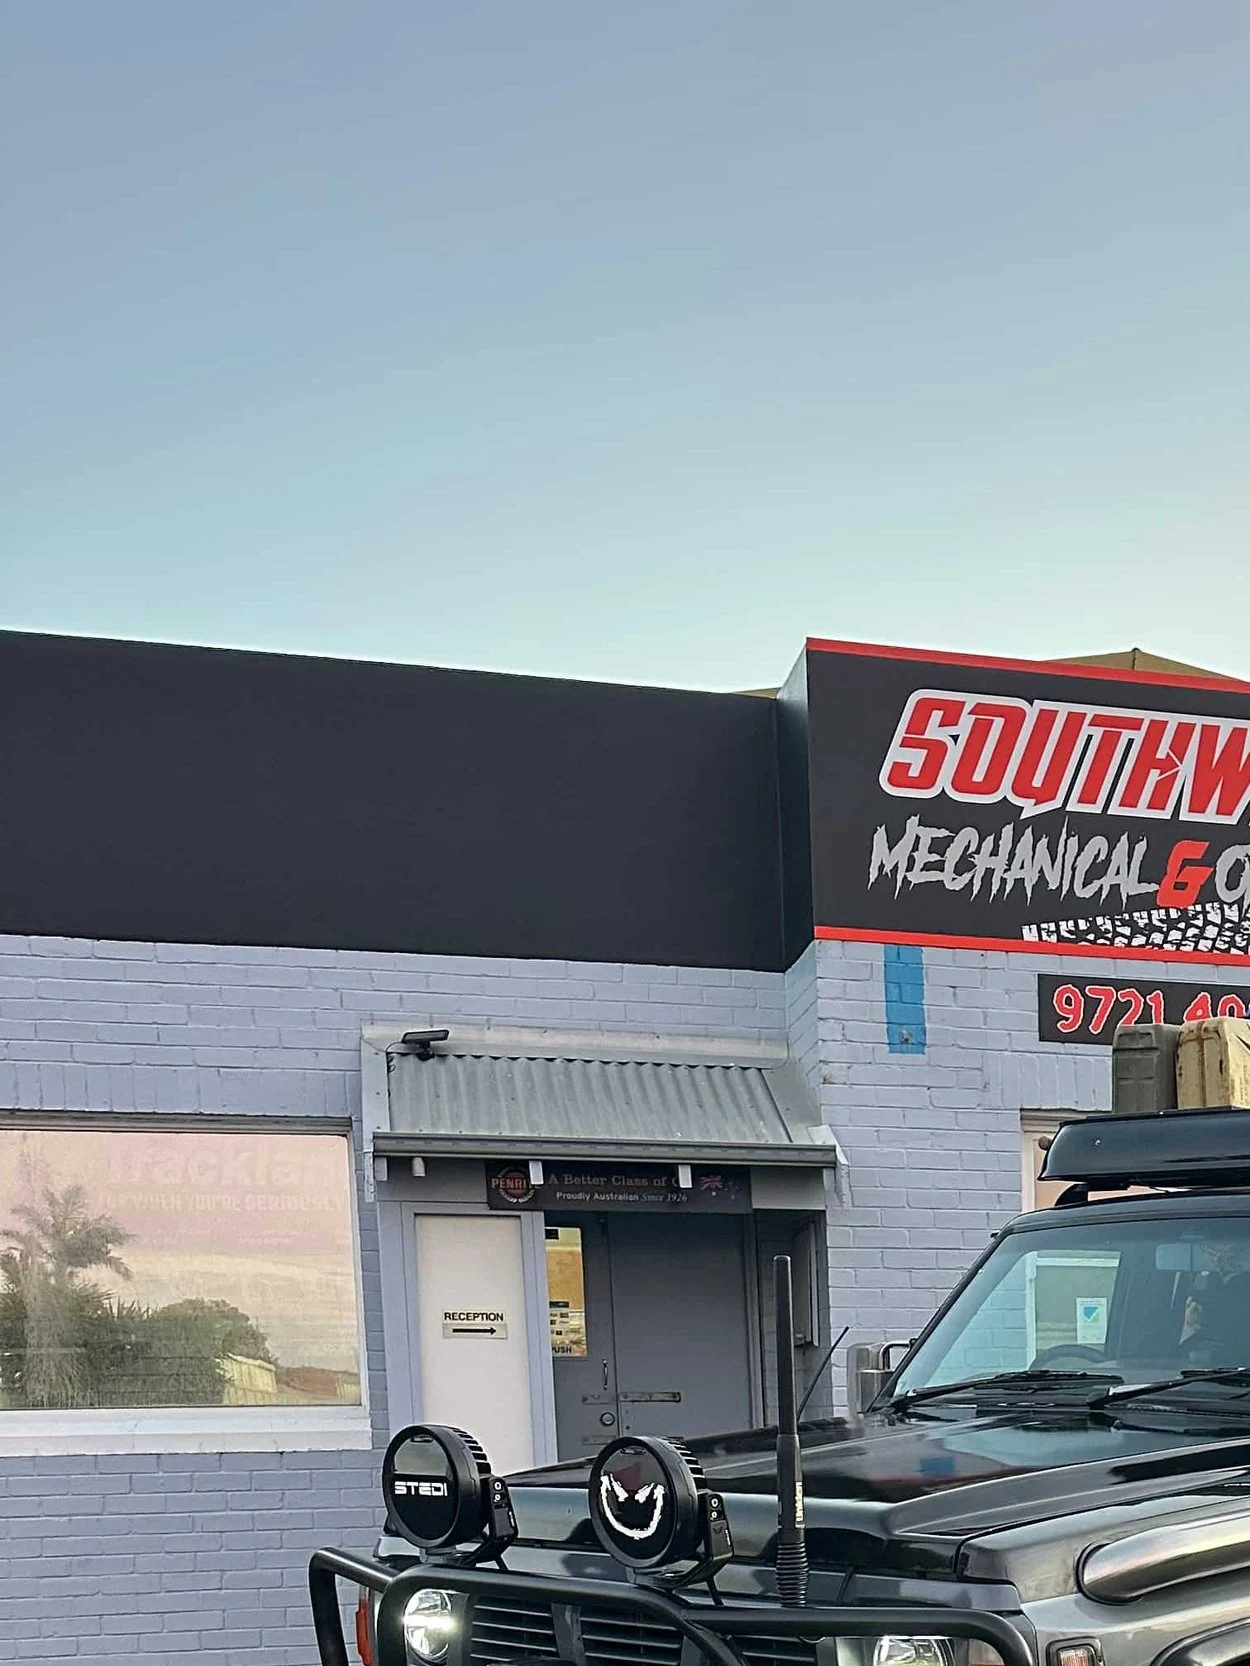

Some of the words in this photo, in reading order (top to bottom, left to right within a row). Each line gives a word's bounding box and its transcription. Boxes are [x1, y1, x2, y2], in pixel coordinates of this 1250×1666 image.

[867, 814, 1160, 910] MECHANICAL
[1053, 984, 1165, 1035] 9721
[491, 1178, 541, 1189] PENRI
[548, 1174, 559, 1185] A
[563, 1174, 607, 1186] Better
[612, 1175, 648, 1187] Class
[653, 1176, 667, 1187] of
[556, 1191, 590, 1201] Proudly
[593, 1192, 639, 1202] Australian
[444, 1312, 504, 1322] RECEPTION
[395, 1481, 448, 1496] STEDI
